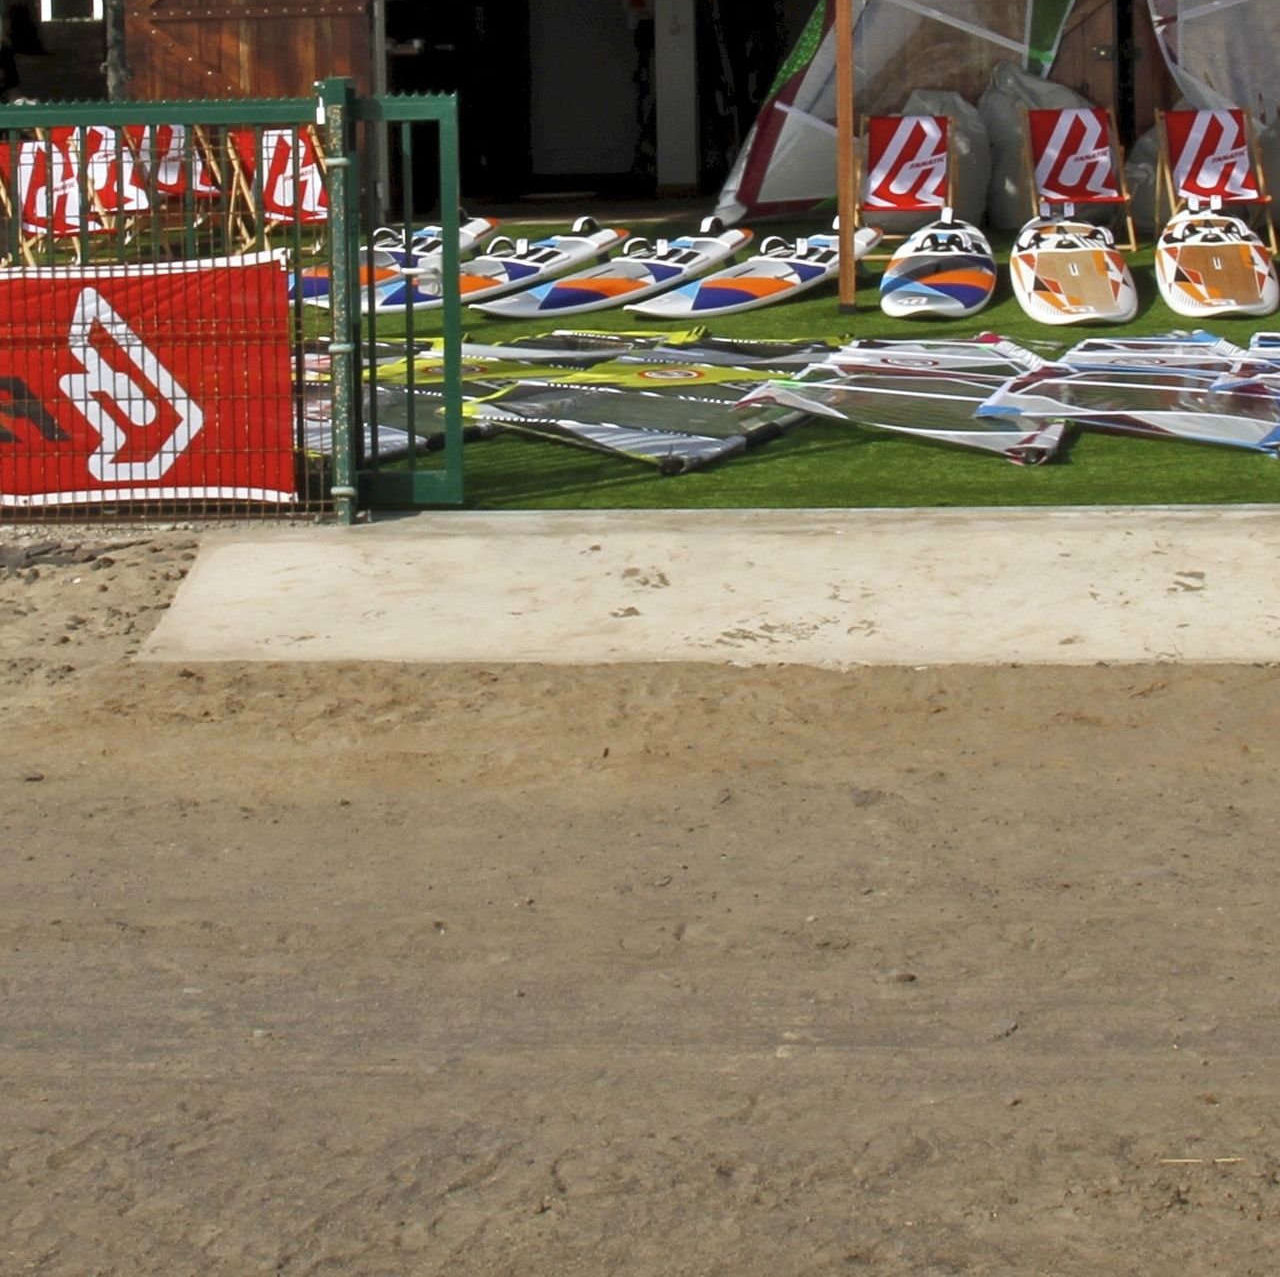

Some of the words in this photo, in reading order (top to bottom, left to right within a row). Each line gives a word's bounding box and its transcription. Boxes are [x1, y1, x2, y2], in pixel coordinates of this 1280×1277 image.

[908, 155, 947, 171] FANATIC
[1072, 149, 1110, 164] FANATIC
[1210, 149, 1248, 165] FANATIC
